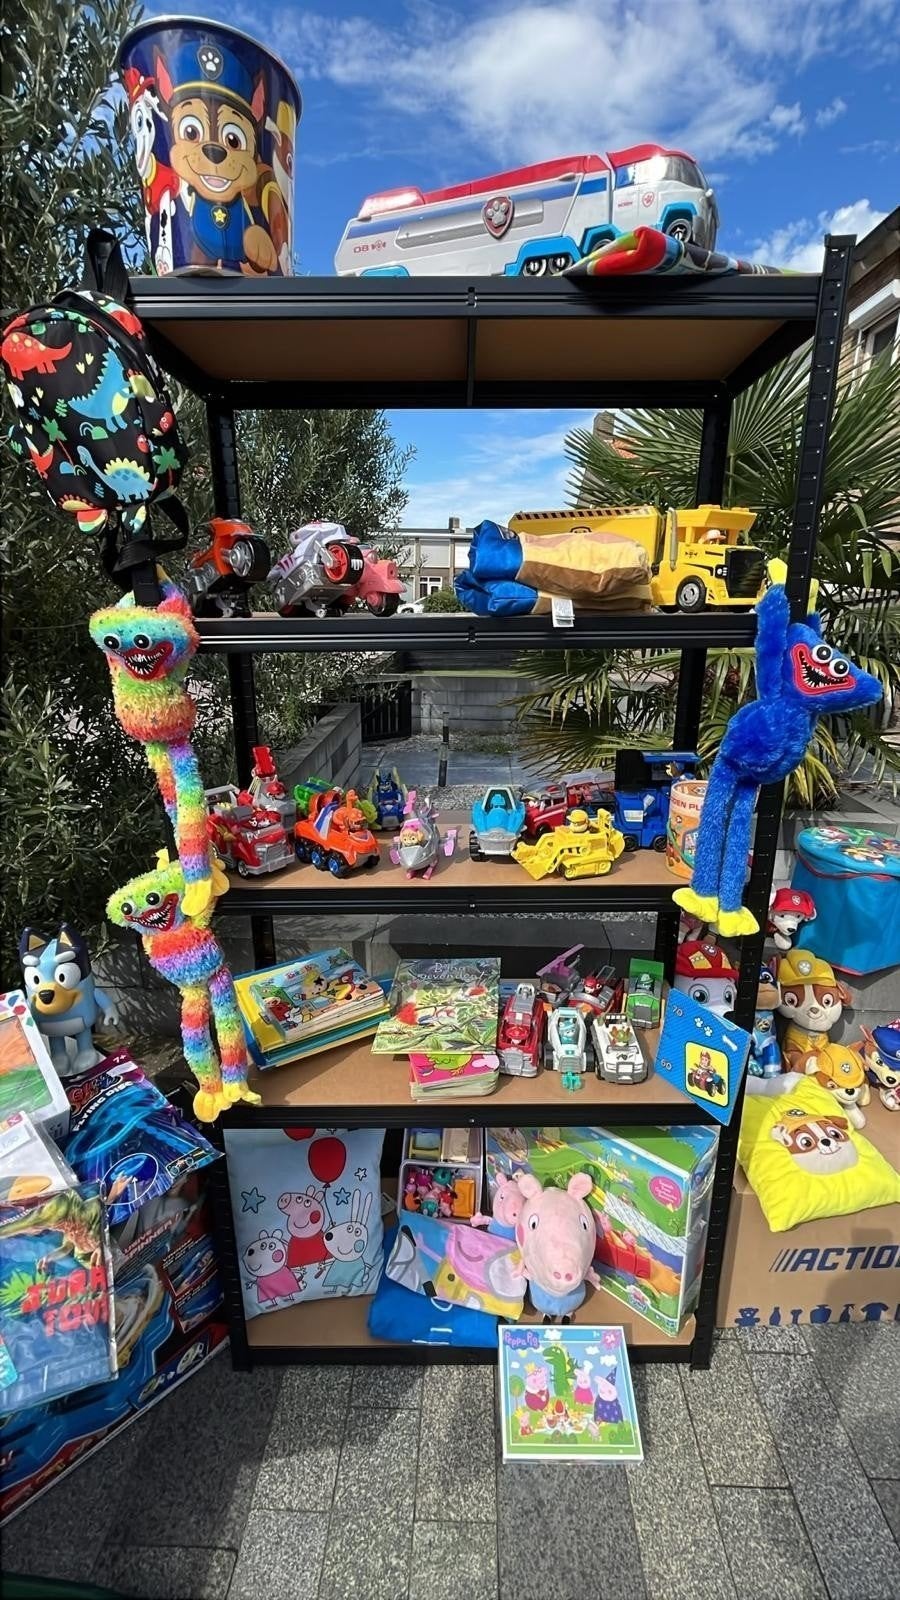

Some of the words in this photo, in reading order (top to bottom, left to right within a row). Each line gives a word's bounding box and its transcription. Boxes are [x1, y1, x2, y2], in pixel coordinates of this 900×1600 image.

[672, 1005, 684, 1017] 70
[112, 1054, 127, 1064] 7+
[660, 1059, 672, 1071] 60
[72, 1096, 107, 1132] FLYING
[105, 1081, 134, 1098] DISC
[789, 1245, 900, 1272] ACTIO
[21, 1265, 108, 1314] JURA
[504, 1331, 526, 1347] Peppa
[526, 1331, 538, 1347] Pig
